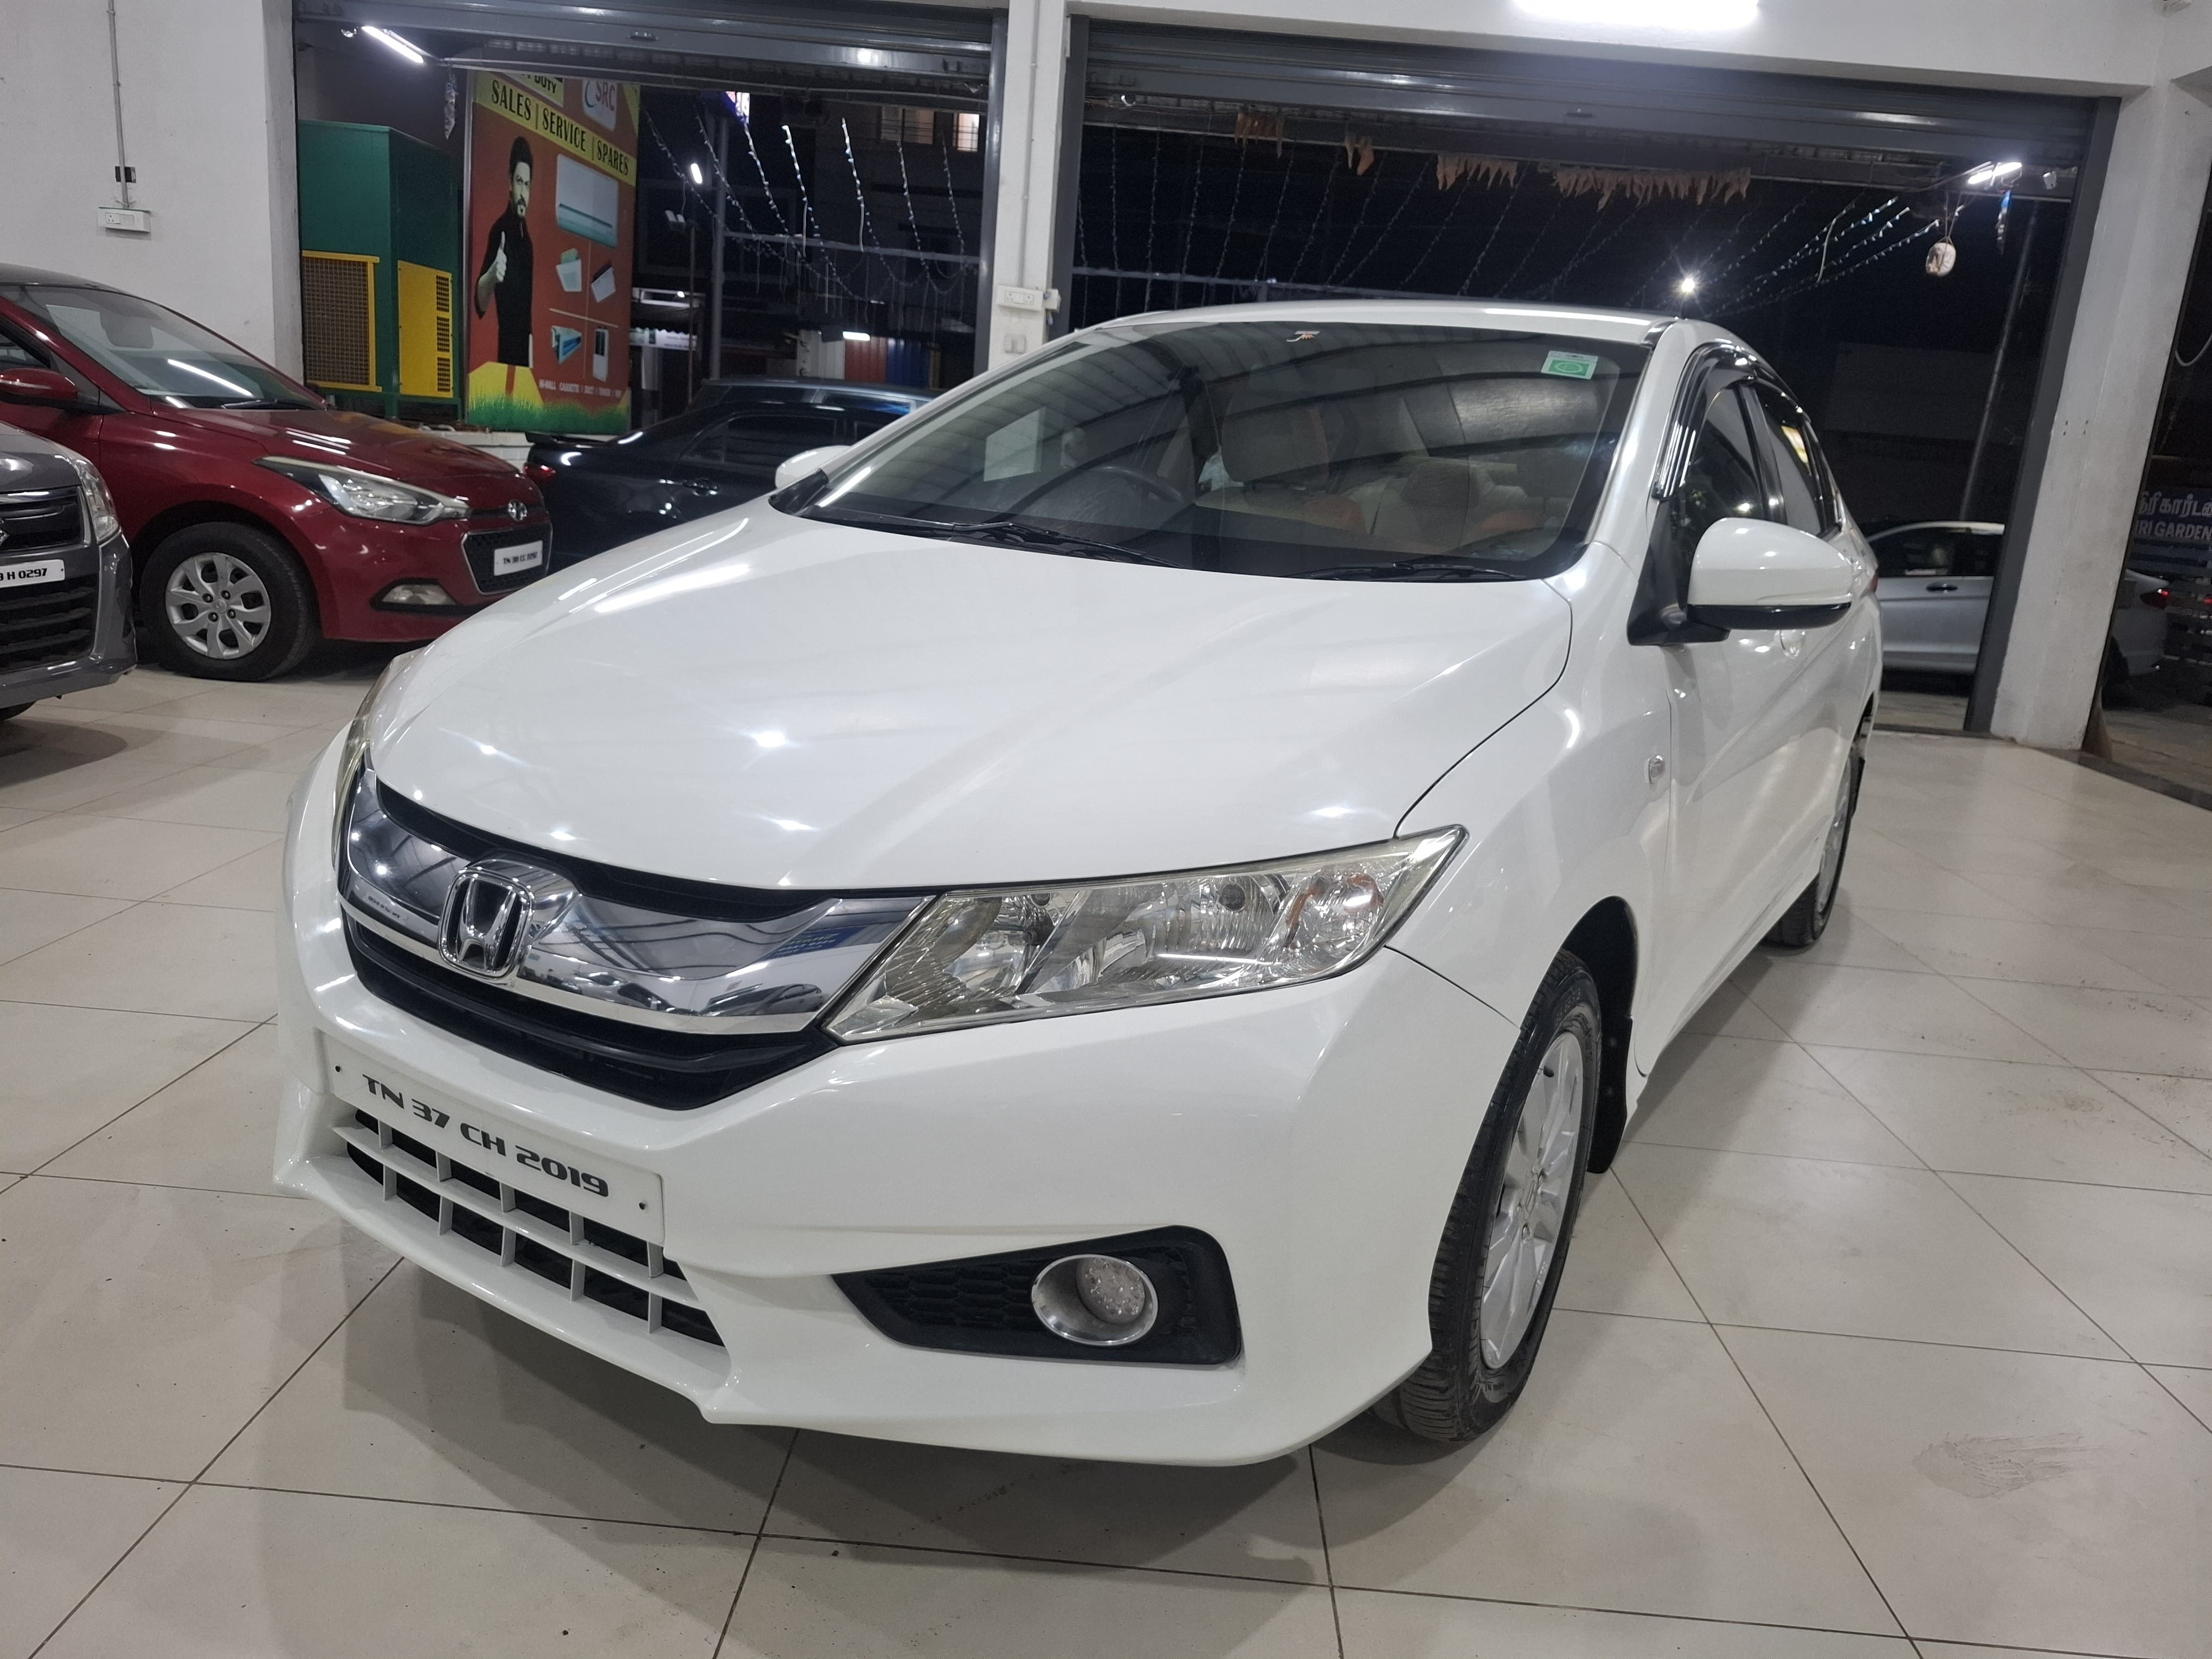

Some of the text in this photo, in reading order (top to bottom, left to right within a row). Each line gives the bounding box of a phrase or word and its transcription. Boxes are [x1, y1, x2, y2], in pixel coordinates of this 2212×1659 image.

[492, 80, 629, 176] SALES SERVICE SPARES
[7, 571, 15, 580] H
[18, 568, 48, 579] 0297
[362, 1073, 609, 1197] TN 37 CH 2019
